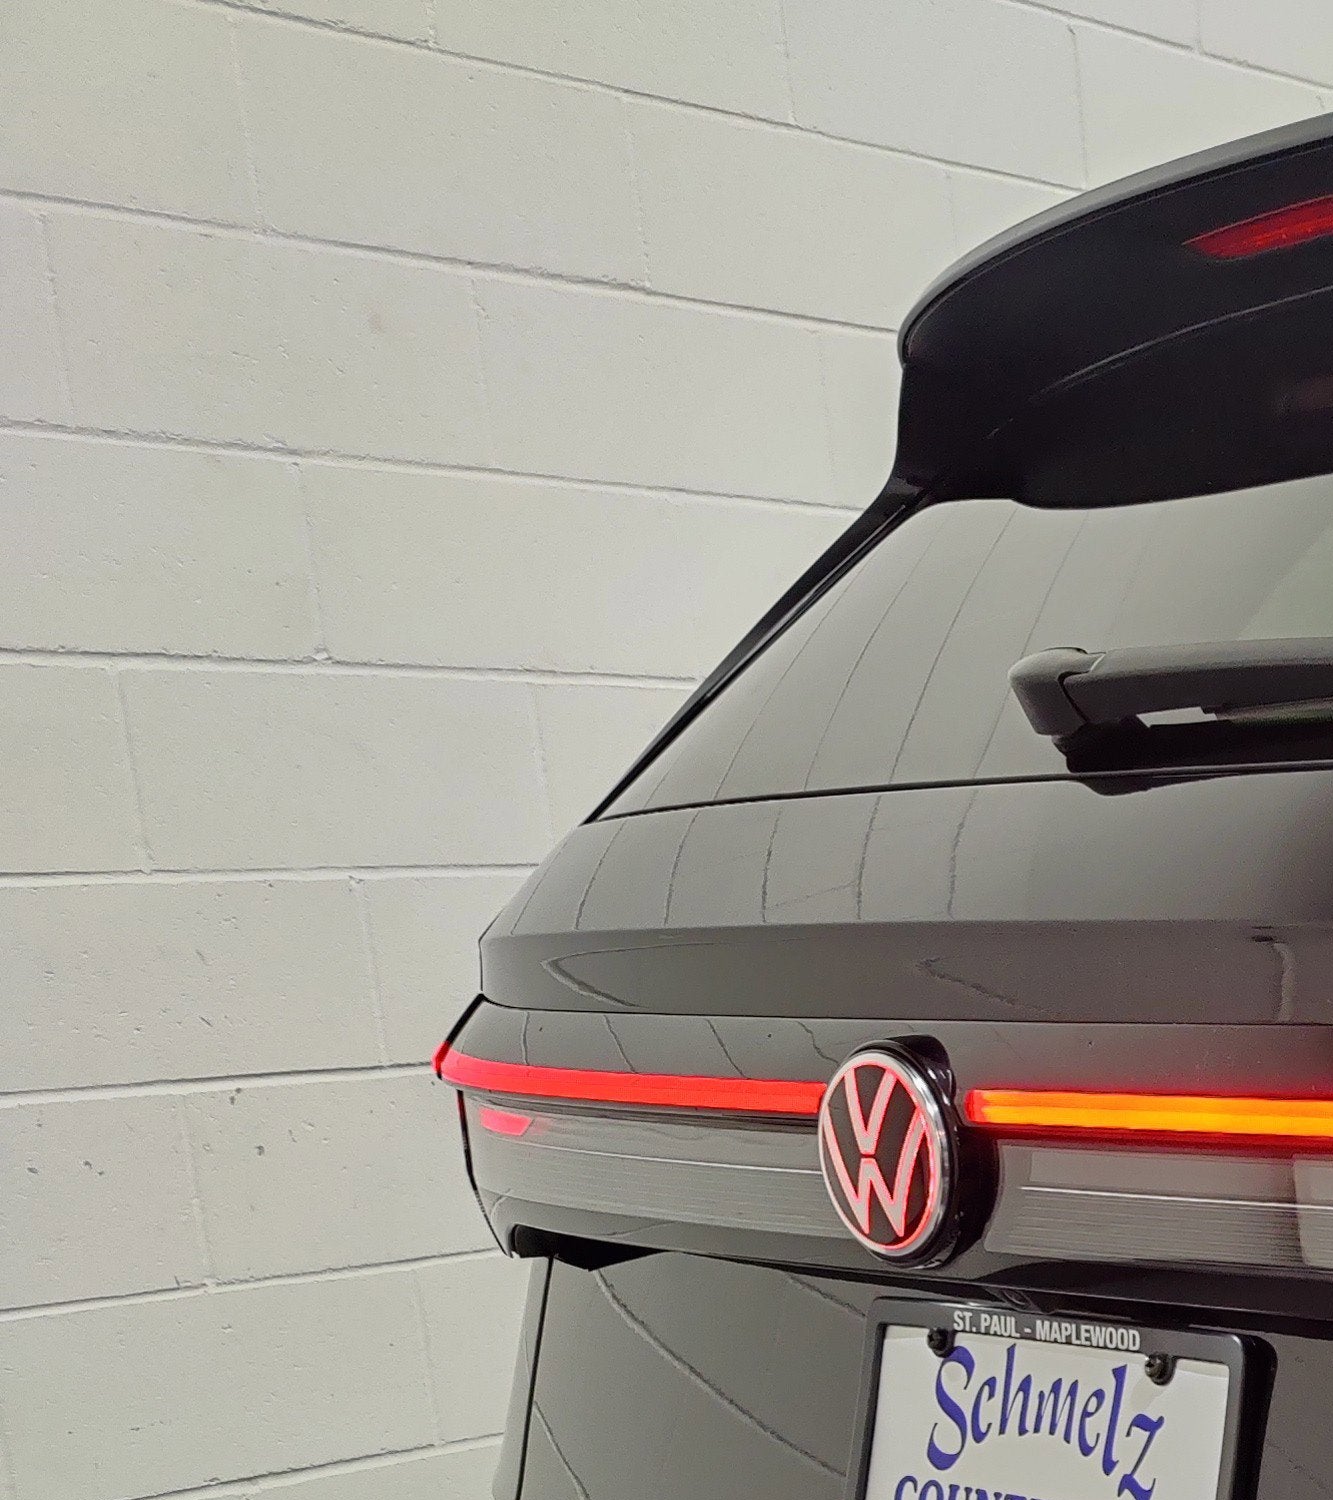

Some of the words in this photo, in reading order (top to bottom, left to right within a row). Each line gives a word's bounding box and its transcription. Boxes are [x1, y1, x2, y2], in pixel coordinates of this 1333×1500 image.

[953, 1310, 976, 1333] ST.
[980, 1313, 1020, 1338] PAUL
[1035, 1319, 1141, 1351] MAPLEWOOD
